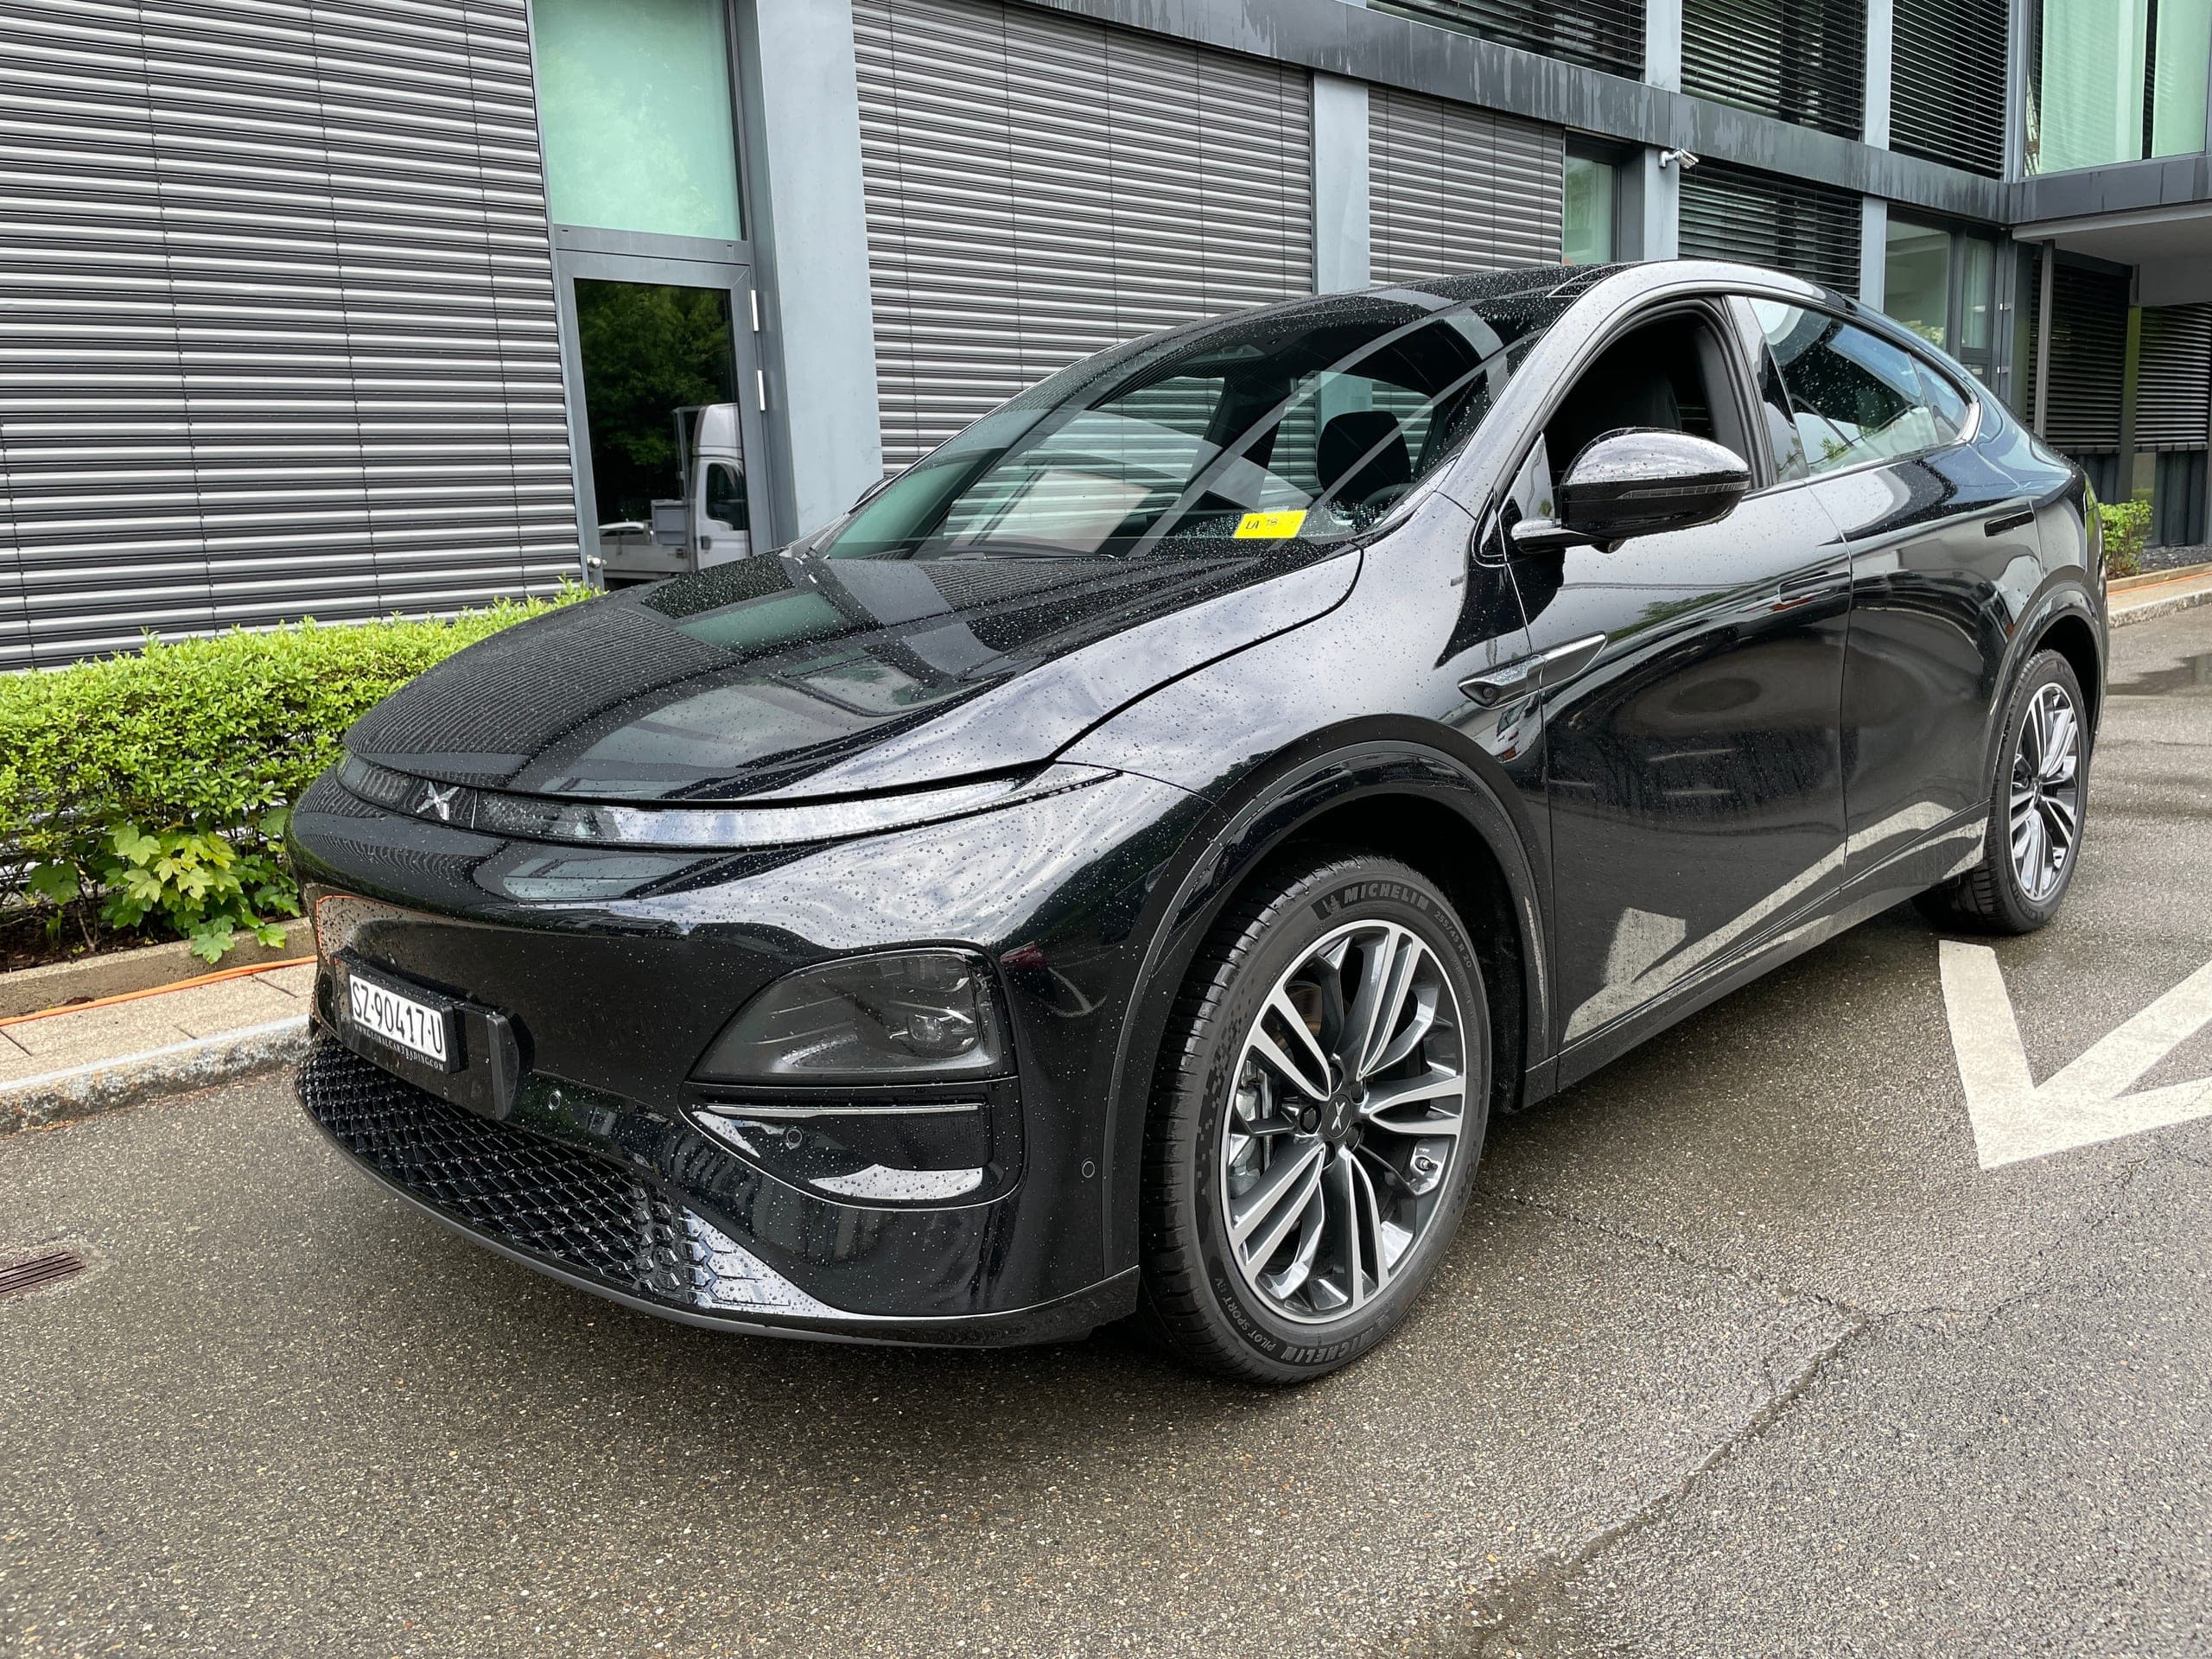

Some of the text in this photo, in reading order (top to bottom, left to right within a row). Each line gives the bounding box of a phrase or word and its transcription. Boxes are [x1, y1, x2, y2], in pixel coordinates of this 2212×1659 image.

[1344, 883, 1429, 909] MICHELIN
[1433, 910, 1460, 944] 255/45
[1462, 953, 1472, 969] 20
[1223, 1296, 1250, 1331] SPORT
[1247, 1329, 1277, 1352] PILOT
[1281, 1327, 1374, 1363] MICHELIN
